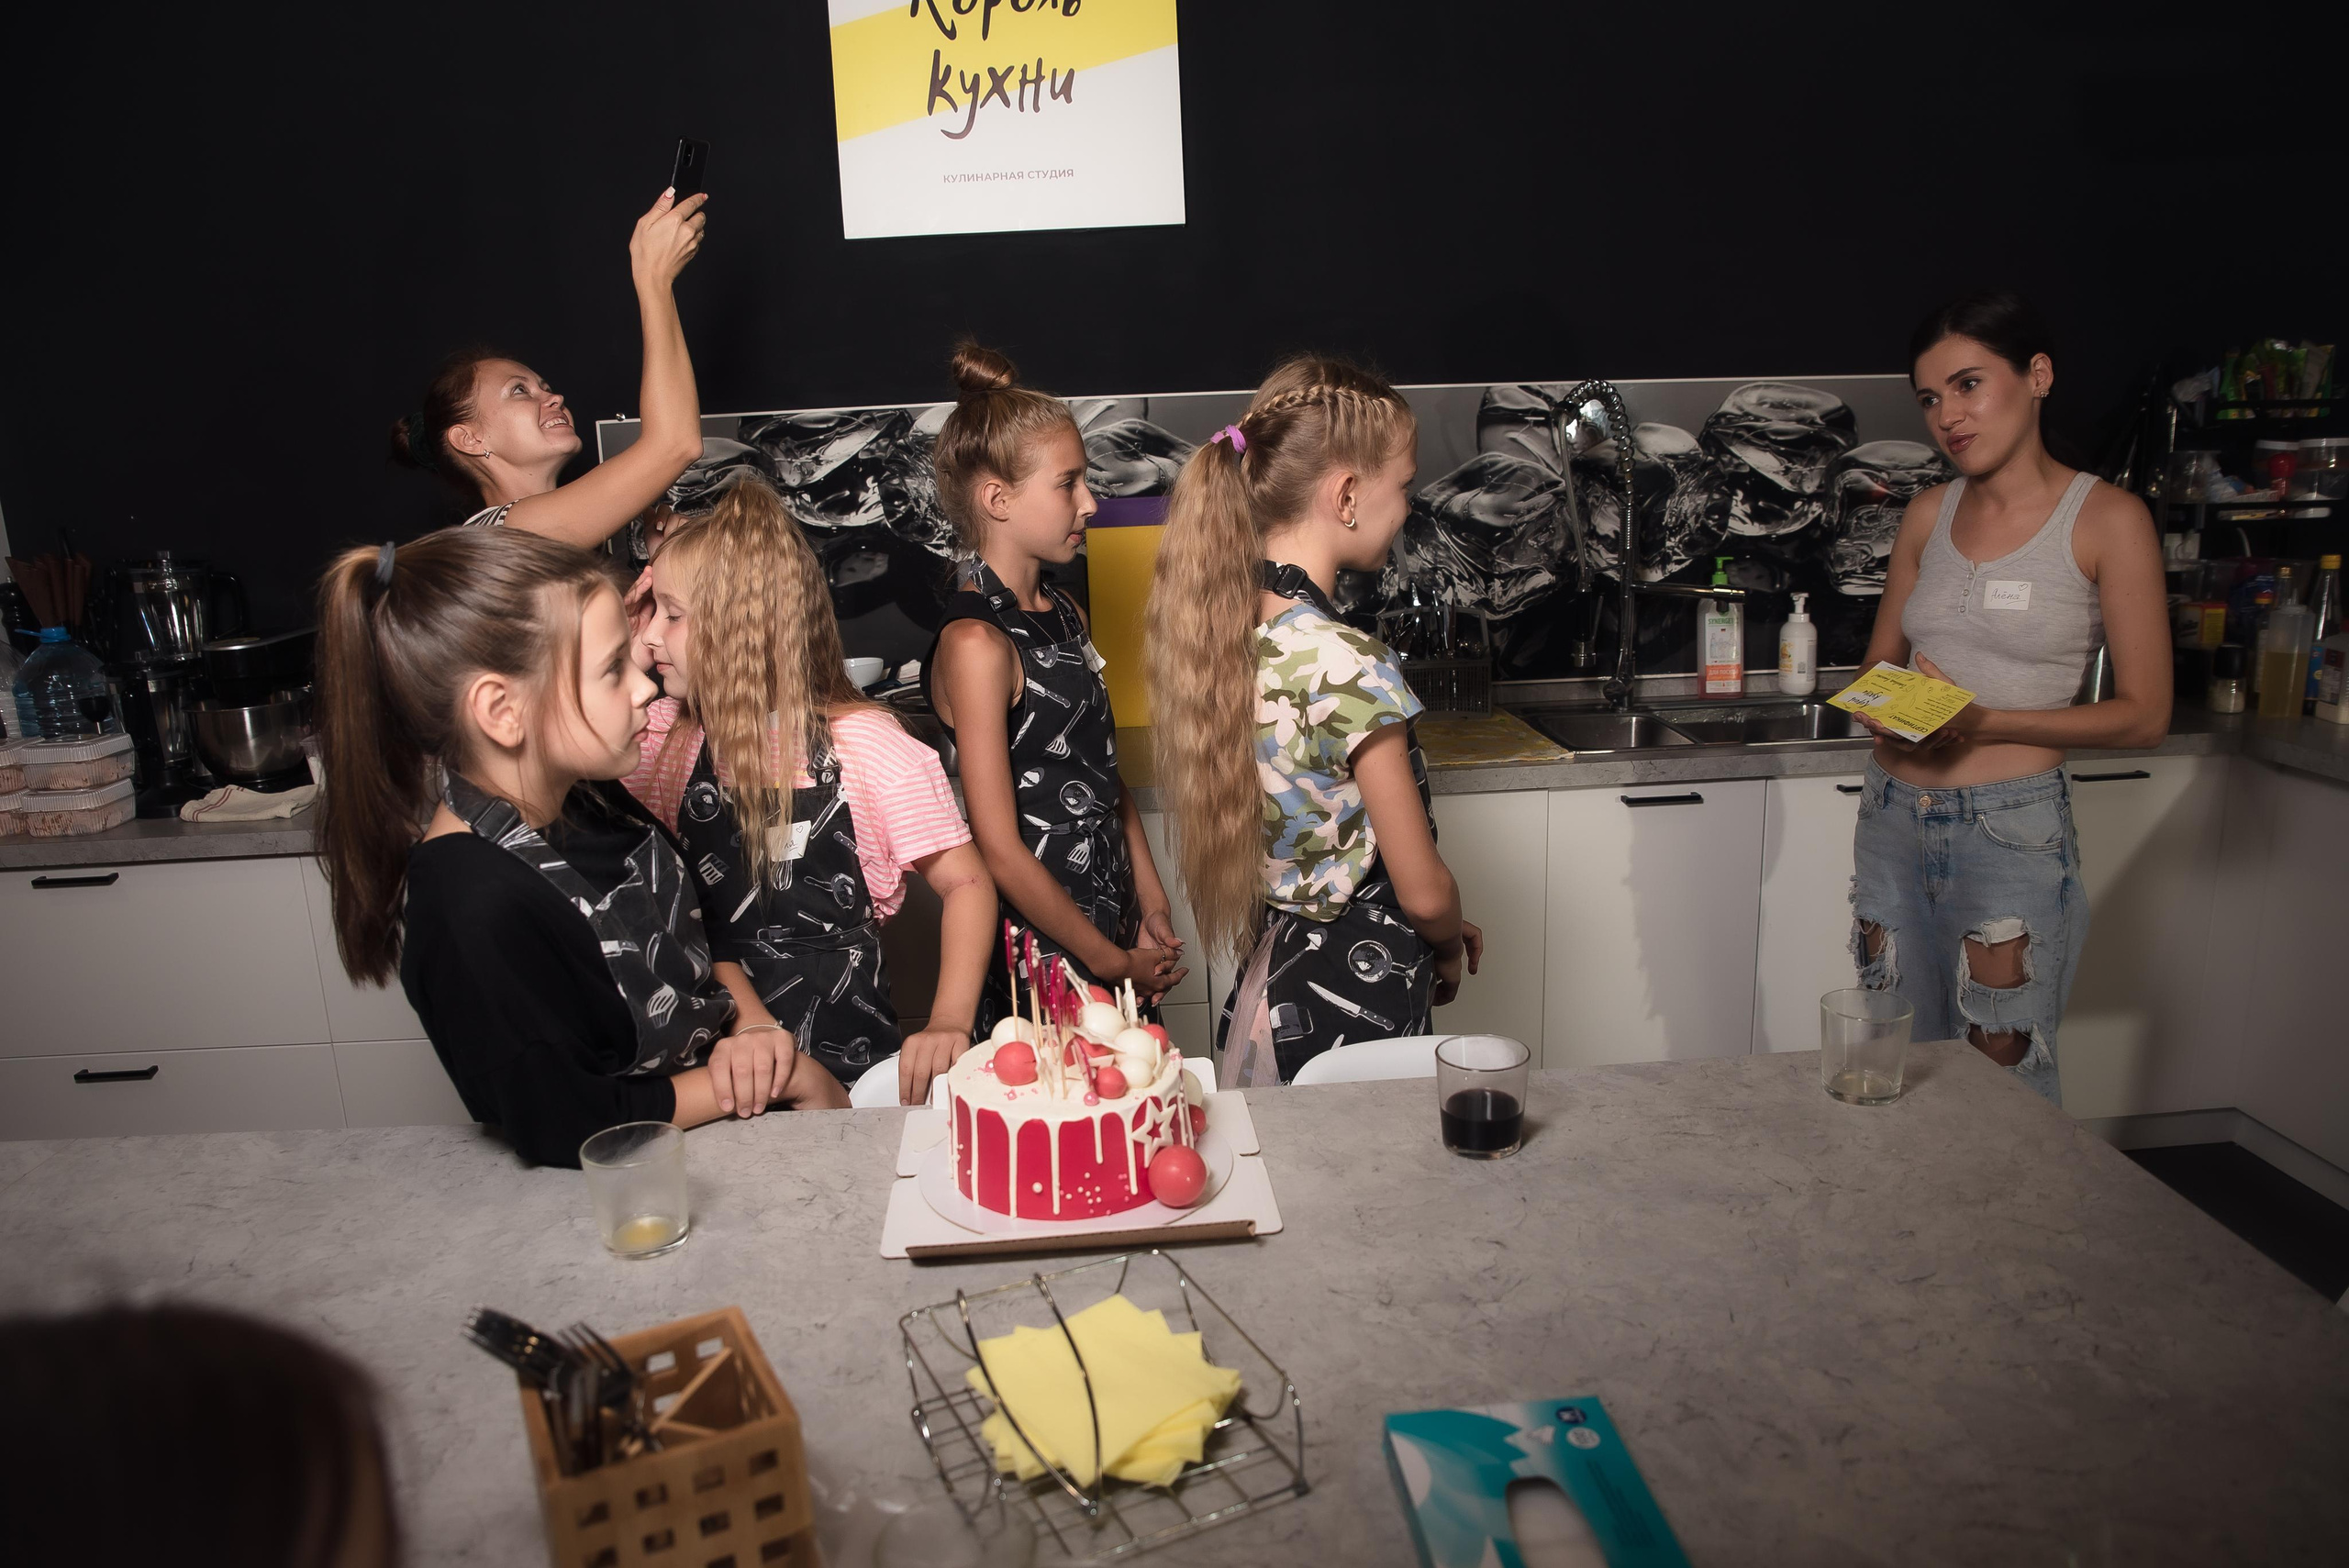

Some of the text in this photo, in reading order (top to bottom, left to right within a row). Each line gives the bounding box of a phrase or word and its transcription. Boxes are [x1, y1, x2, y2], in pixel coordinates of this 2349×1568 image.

[943, 169, 1074, 183] КУЛИНАРНАЯ СТУДИЯ
[1888, 715, 1928, 733] СЕРТИФИКАТ
